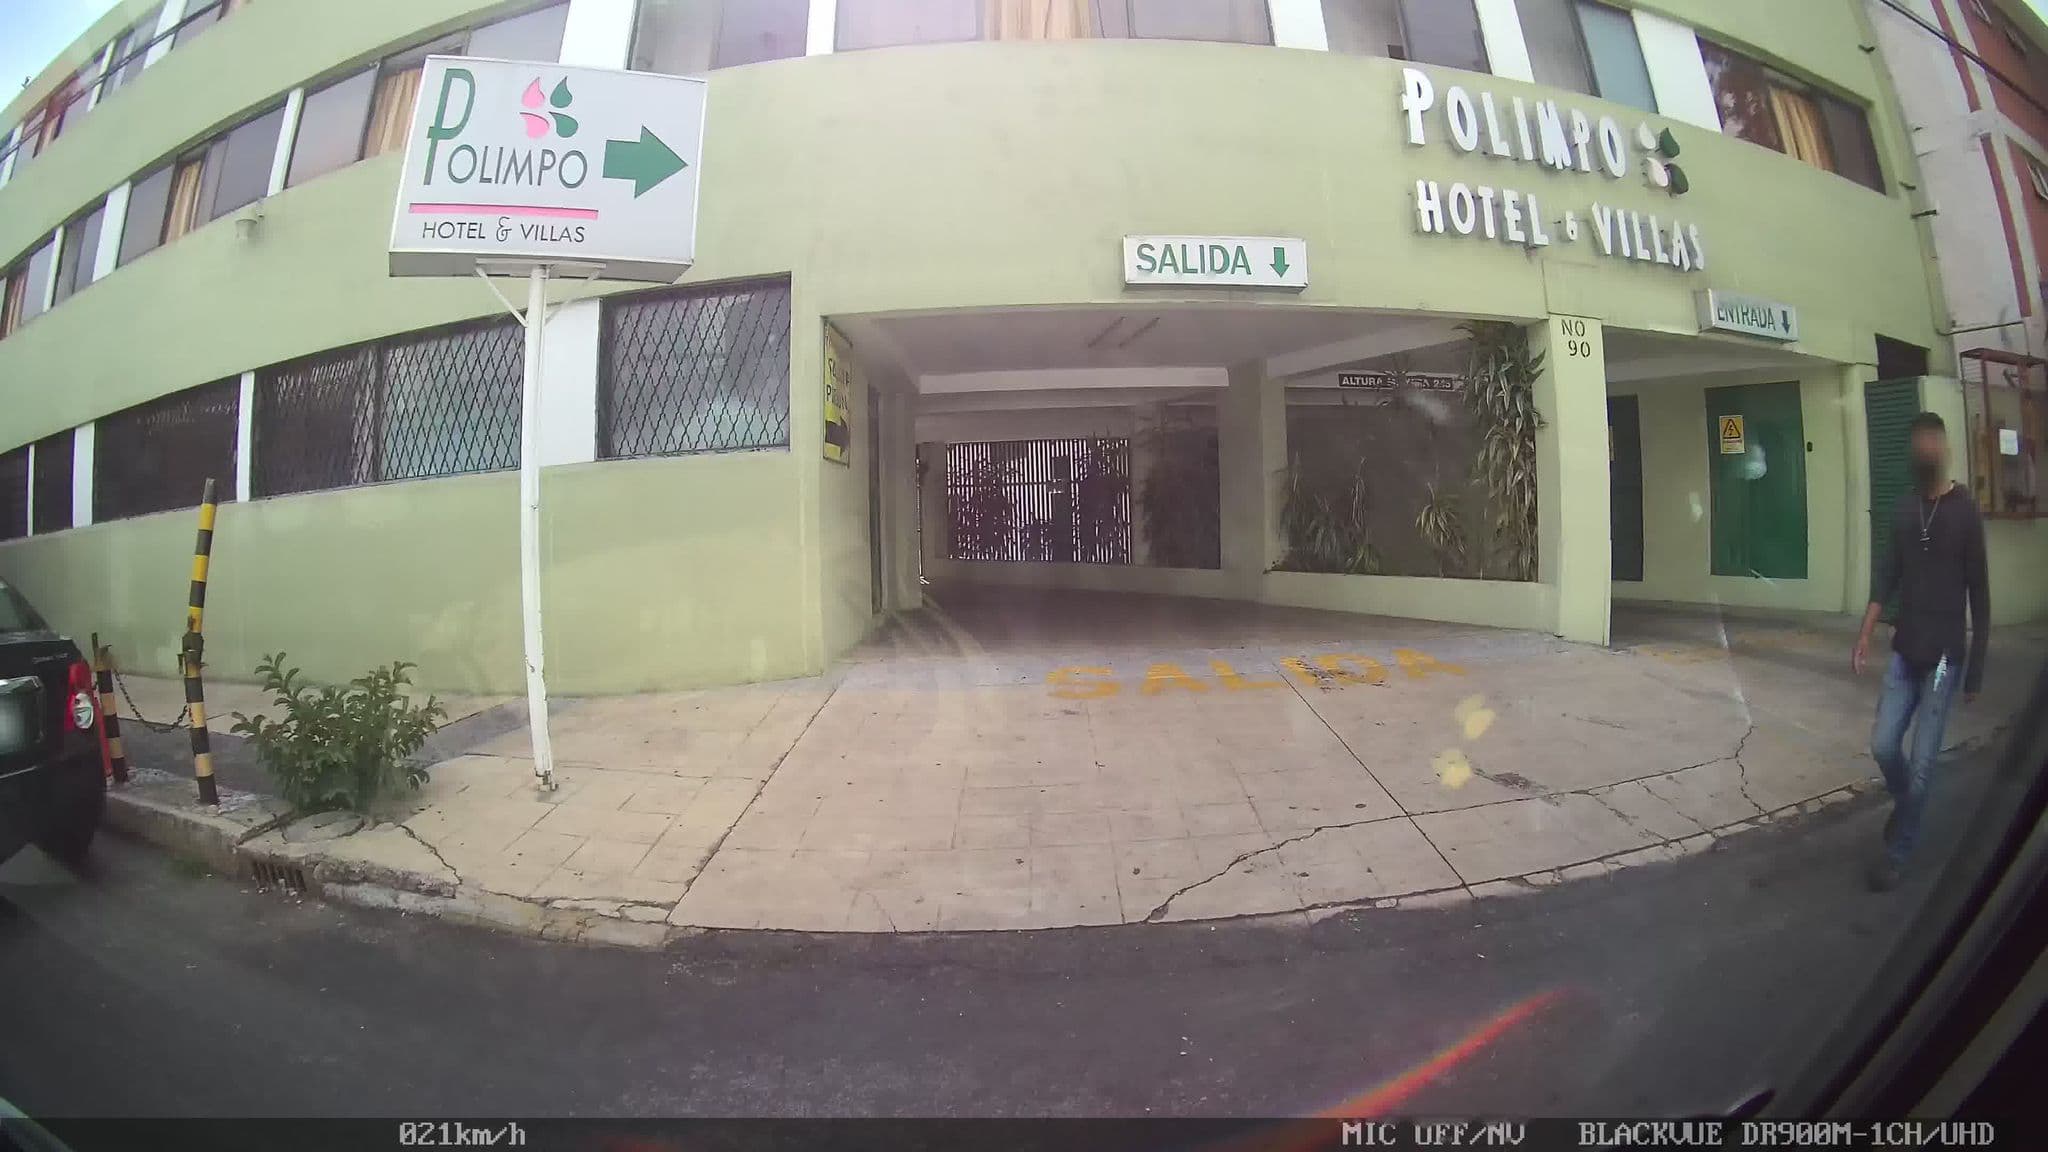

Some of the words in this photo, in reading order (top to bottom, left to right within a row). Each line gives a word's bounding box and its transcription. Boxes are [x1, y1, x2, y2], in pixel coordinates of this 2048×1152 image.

[423, 67, 588, 189] POLIMPO
[1401, 67, 1626, 178] POLIMPO
[422, 221, 486, 239] HOTEL
[496, 216, 512, 242] &
[520, 223, 586, 243] VILLAS
[1415, 179, 1549, 246] HOTEL
[1591, 200, 1705, 273] VILLAS
[1136, 243, 1252, 275] SALIDA
[1561, 319, 1586, 337] NO
[1716, 303, 1777, 332] ENTRADA
[1568, 340, 1591, 358] 90
[1046, 647, 1467, 700] SALIDA
